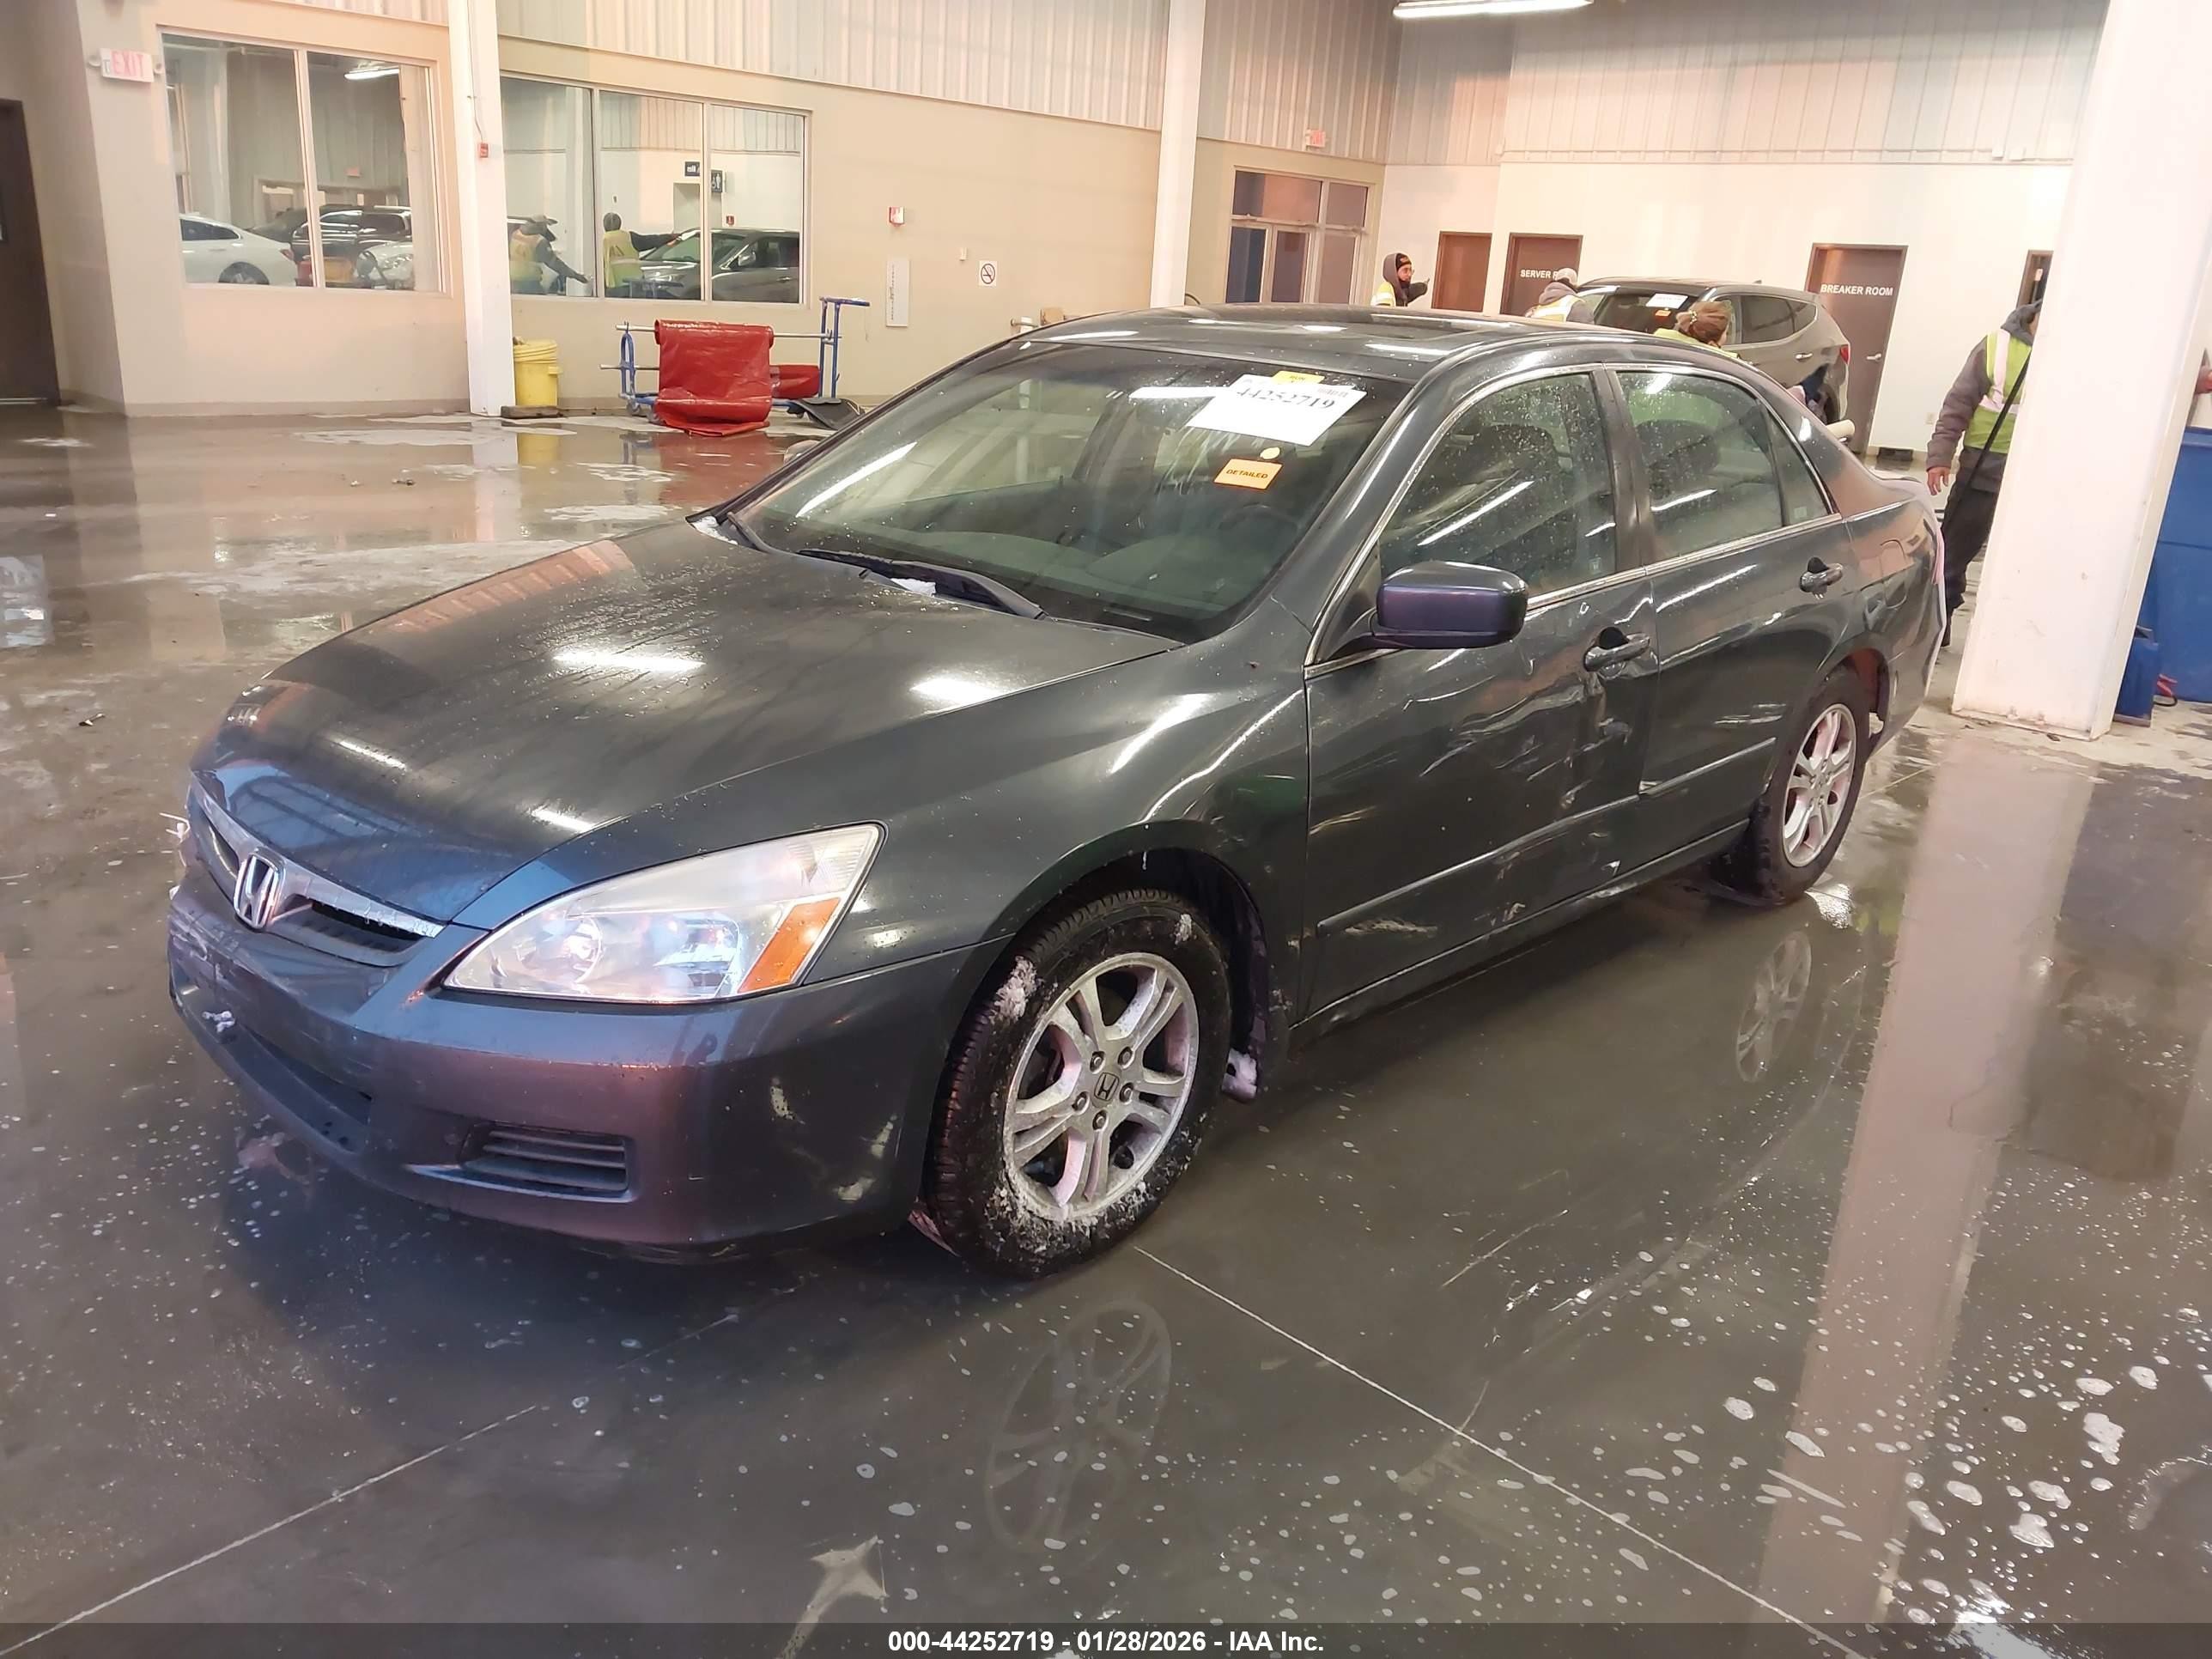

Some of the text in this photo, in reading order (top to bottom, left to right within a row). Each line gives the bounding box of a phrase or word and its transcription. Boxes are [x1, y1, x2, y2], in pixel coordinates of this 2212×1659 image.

[112, 51, 144, 77] EXIT
[1520, 269, 1552, 279] SERVER
[1820, 283, 1893, 296] BREAKER ROOM
[1225, 469, 1268, 479] DETAILED
